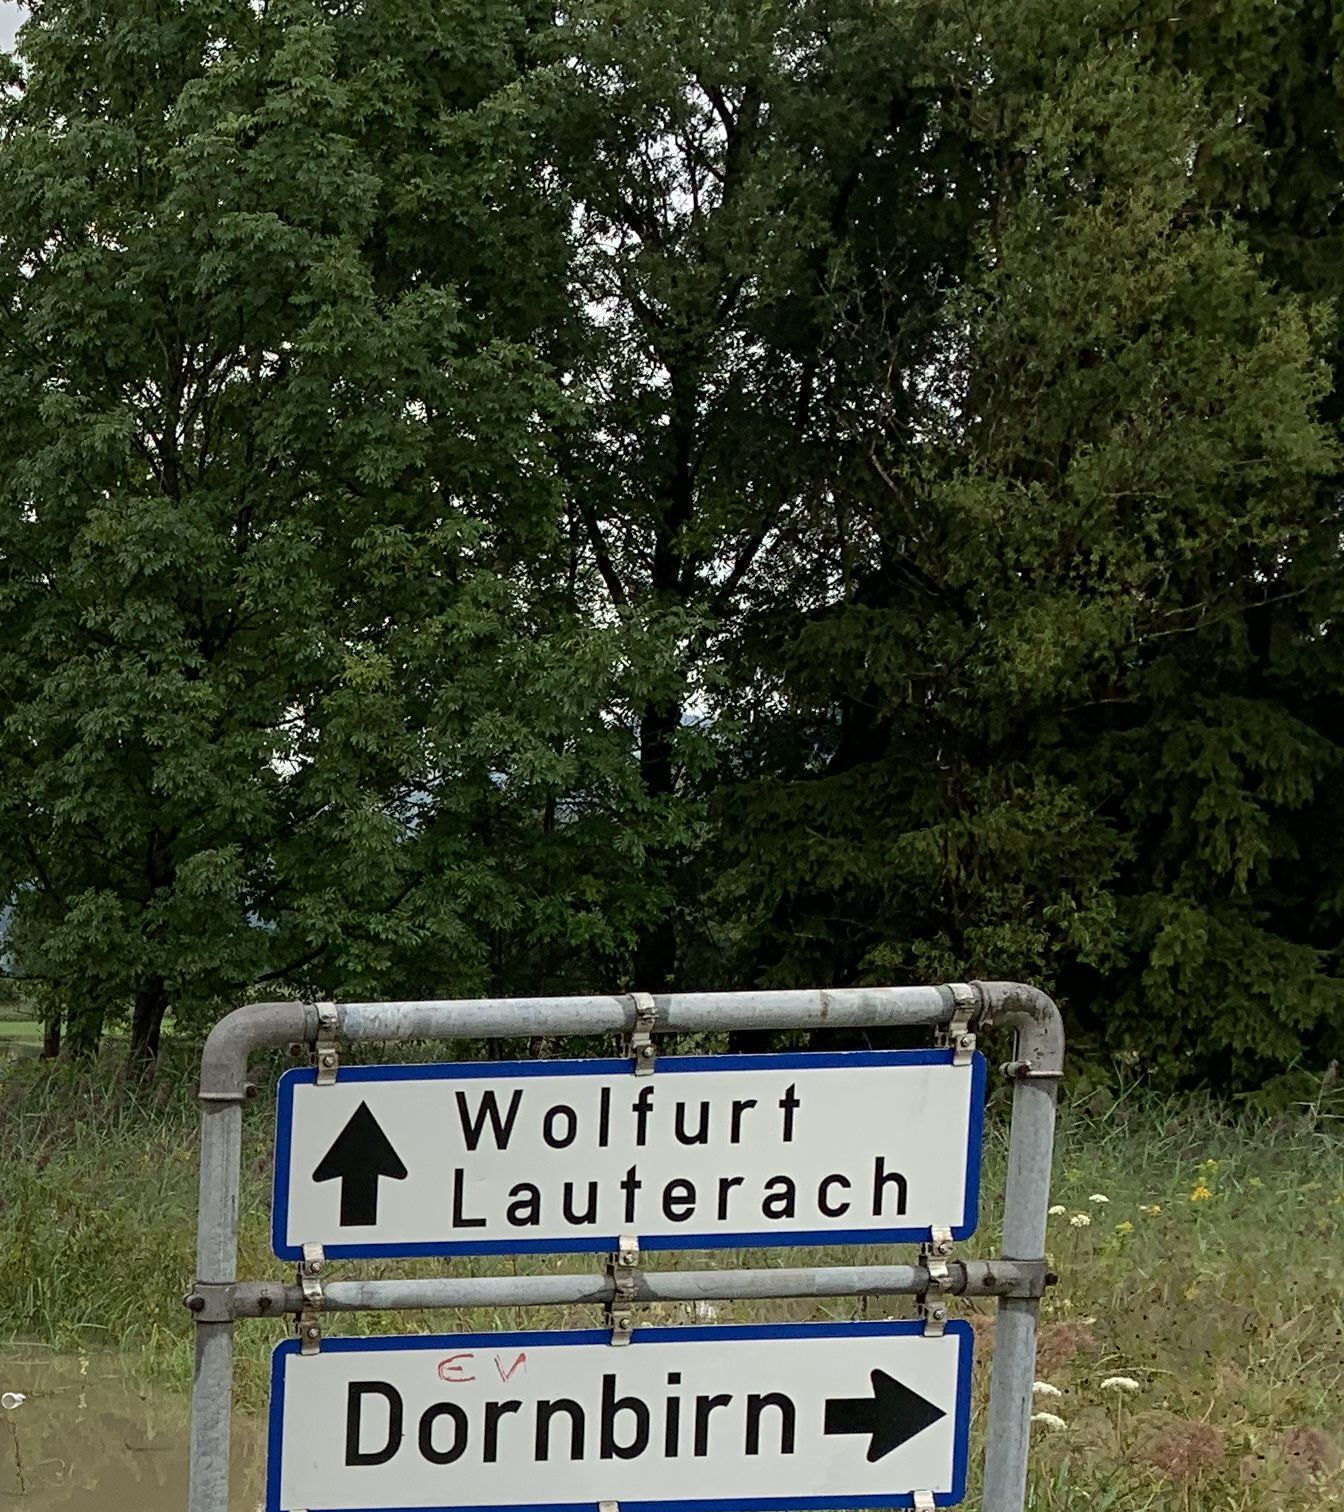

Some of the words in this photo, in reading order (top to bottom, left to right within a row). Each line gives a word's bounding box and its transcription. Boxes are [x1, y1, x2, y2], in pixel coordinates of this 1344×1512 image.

[455, 1082, 802, 1152] Wolfurt
[451, 1155, 909, 1229] Lauterach
[345, 1371, 797, 1467] Dornbirn
